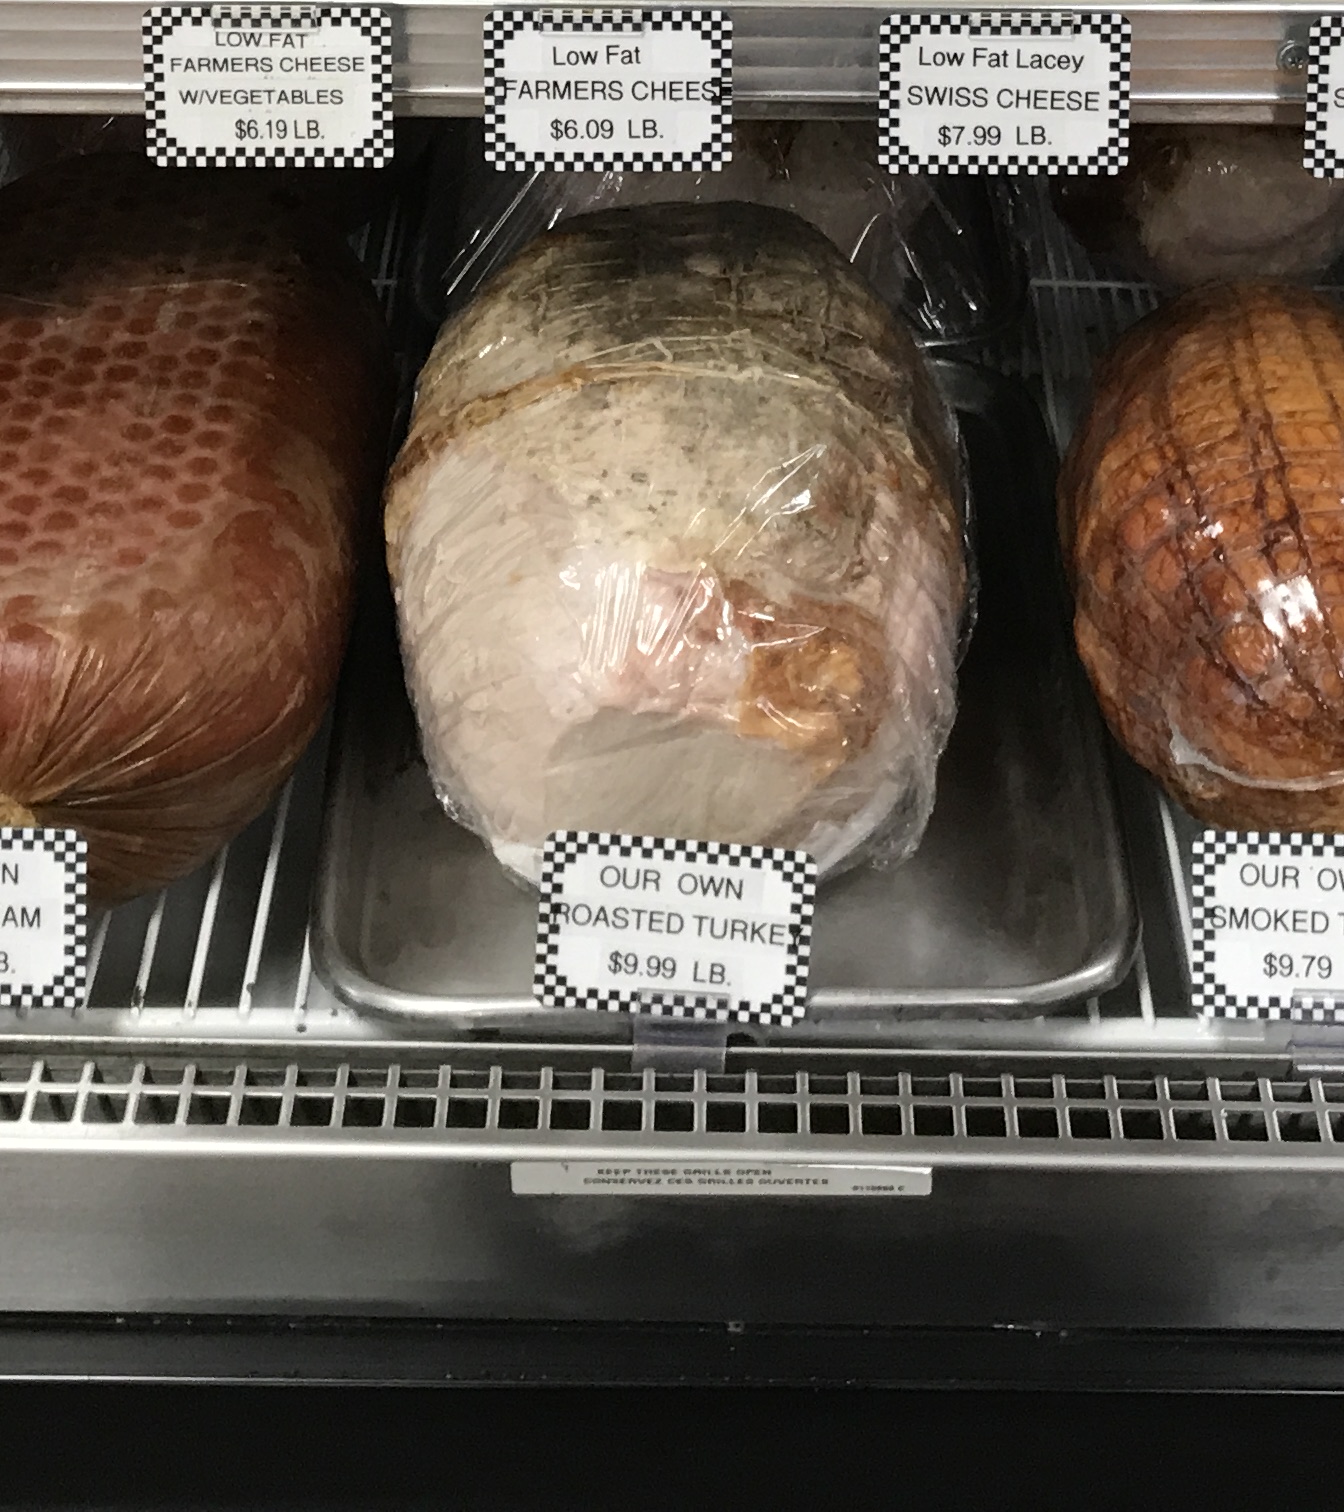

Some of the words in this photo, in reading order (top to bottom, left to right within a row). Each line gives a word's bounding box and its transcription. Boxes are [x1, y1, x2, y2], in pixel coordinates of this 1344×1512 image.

[215, 32, 261, 48] LOW
[269, 33, 309, 49] FAT
[170, 57, 274, 73] FARMERS
[279, 57, 366, 73] CHEESE
[552, 46, 598, 67] Low
[606, 45, 641, 65] Fat
[918, 46, 965, 67] Low
[973, 47, 1010, 68] Fat
[1016, 49, 1084, 73] Lacey
[178, 90, 344, 106] W/VEGETABLES
[504, 80, 624, 101] FARMERS
[907, 85, 988, 108] SWISS
[996, 88, 1101, 112] CHEESE
[235, 118, 288, 140] $6.19
[294, 120, 325, 140] LB.
[550, 118, 614, 141] $6.09
[628, 119, 664, 140] LB.
[938, 125, 1001, 147] $7.99
[1016, 126, 1053, 146] LB.
[600, 865, 661, 891] OUR
[677, 872, 744, 900] OWN
[1239, 862, 1300, 889] OUR
[553, 902, 685, 934] ROASTED
[1209, 904, 1330, 934] SMOKED
[608, 950, 677, 979] $9.99
[693, 960, 732, 986] LB.
[1263, 952, 1332, 978] $9.79
